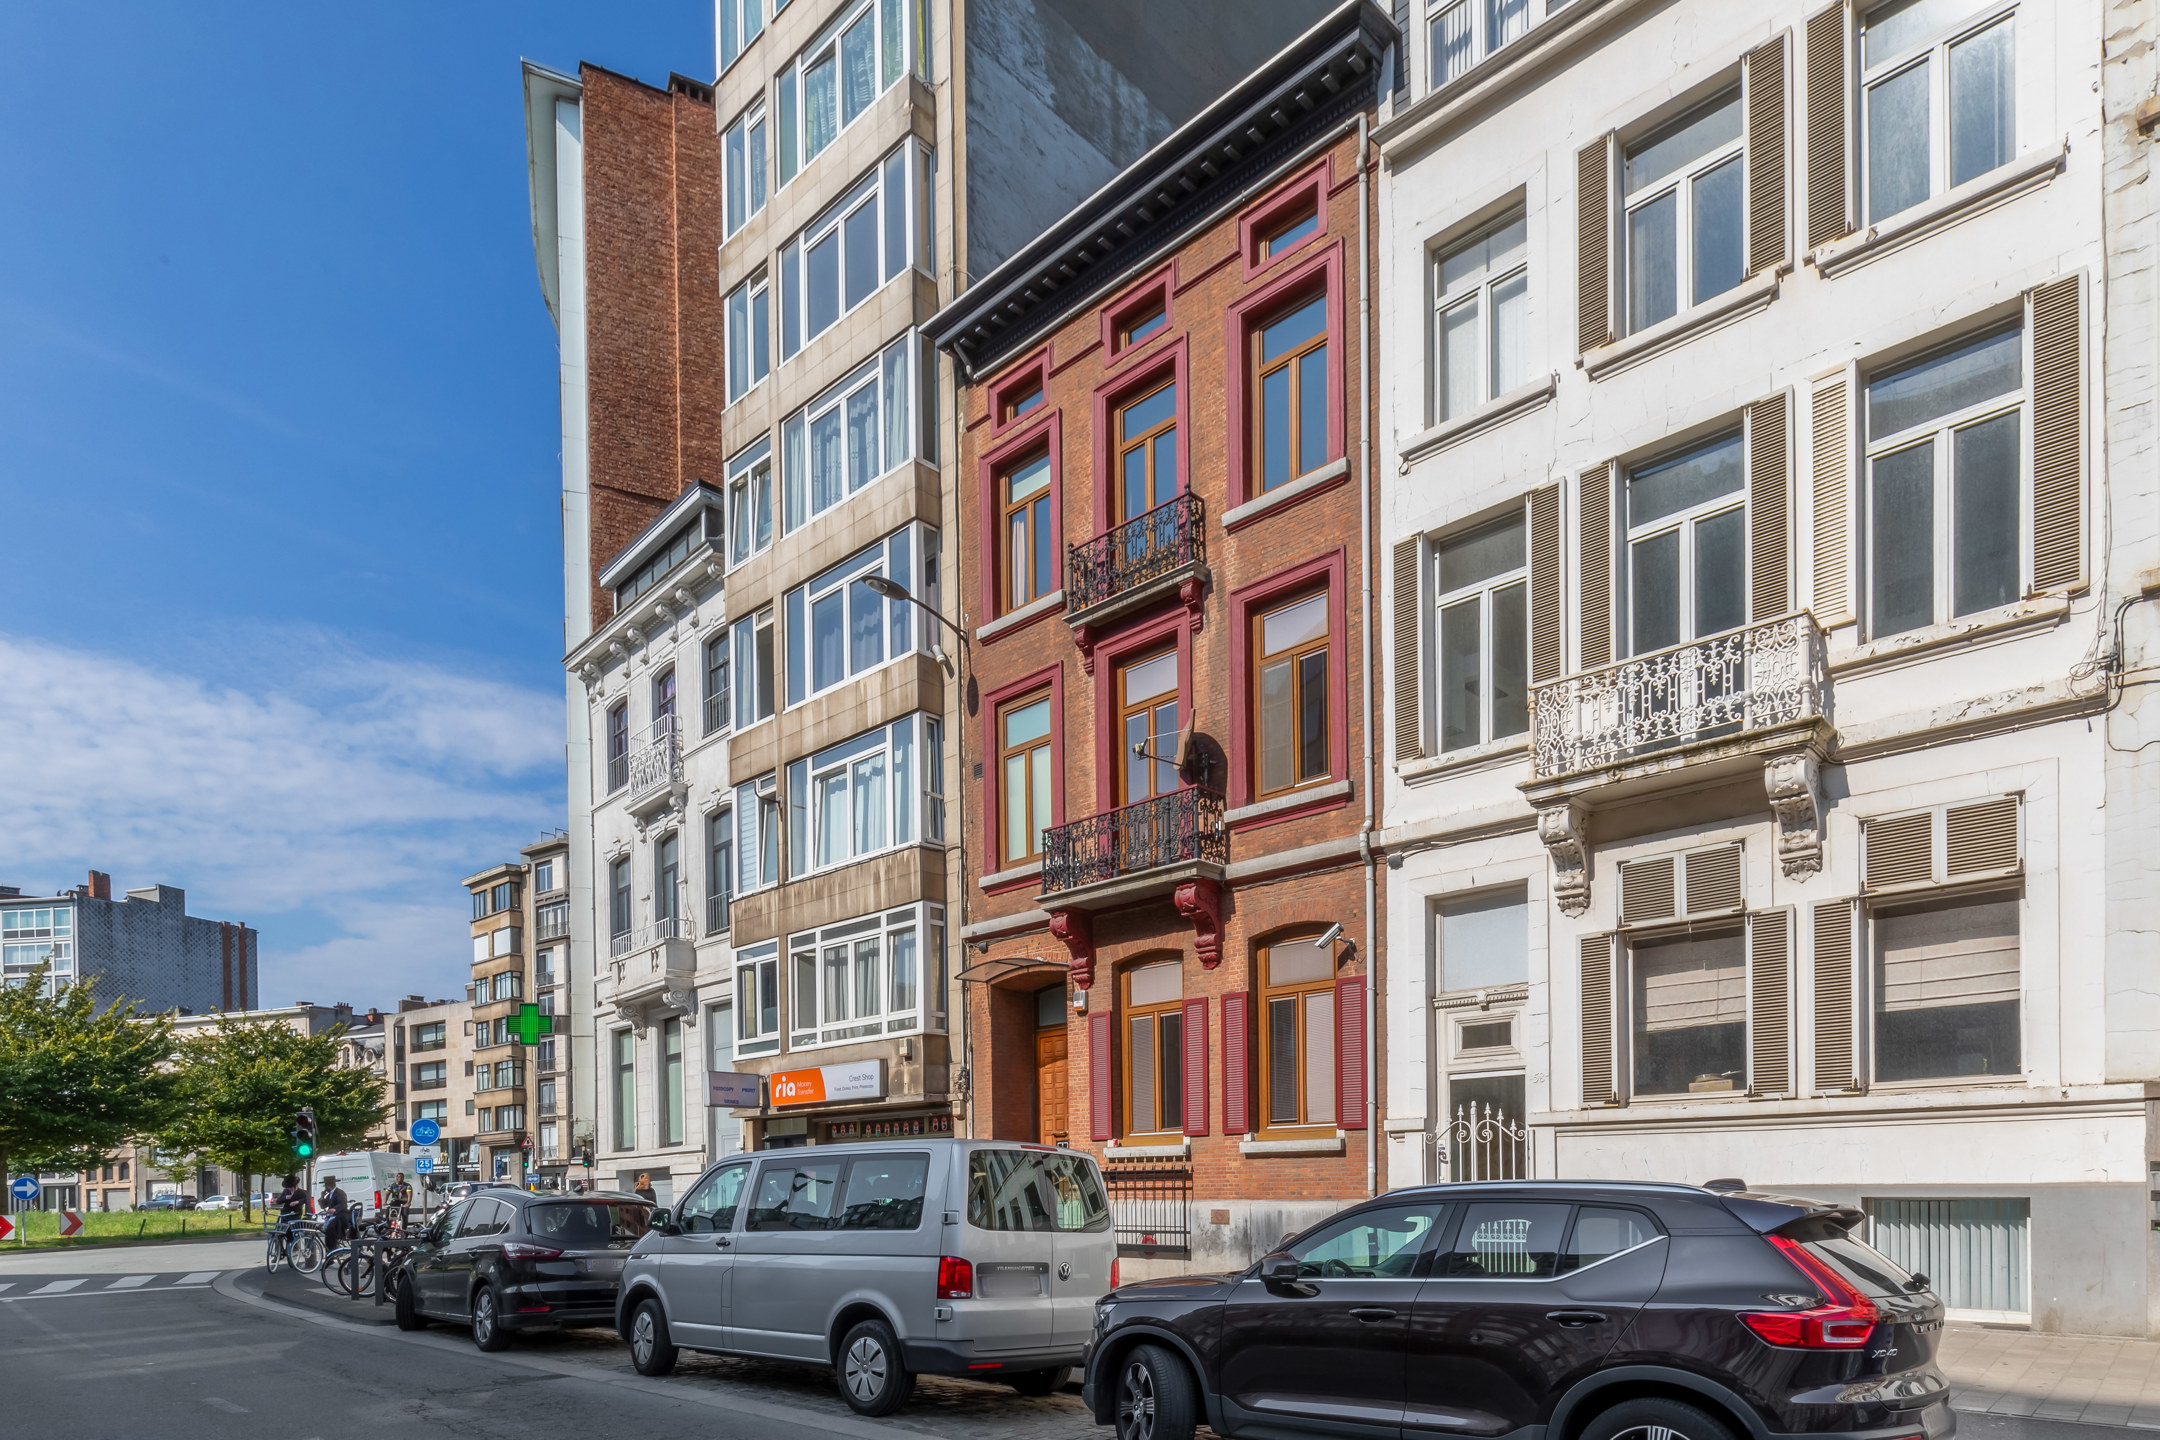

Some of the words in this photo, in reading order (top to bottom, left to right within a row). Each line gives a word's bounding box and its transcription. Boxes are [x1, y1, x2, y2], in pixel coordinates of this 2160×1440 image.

[862, 1073, 875, 1081] Shop
[776, 1075, 796, 1098] ria
[797, 1088, 815, 1096] Transfer
[419, 1160, 430, 1168] 25
[1872, 1348, 1898, 1358] XC40
